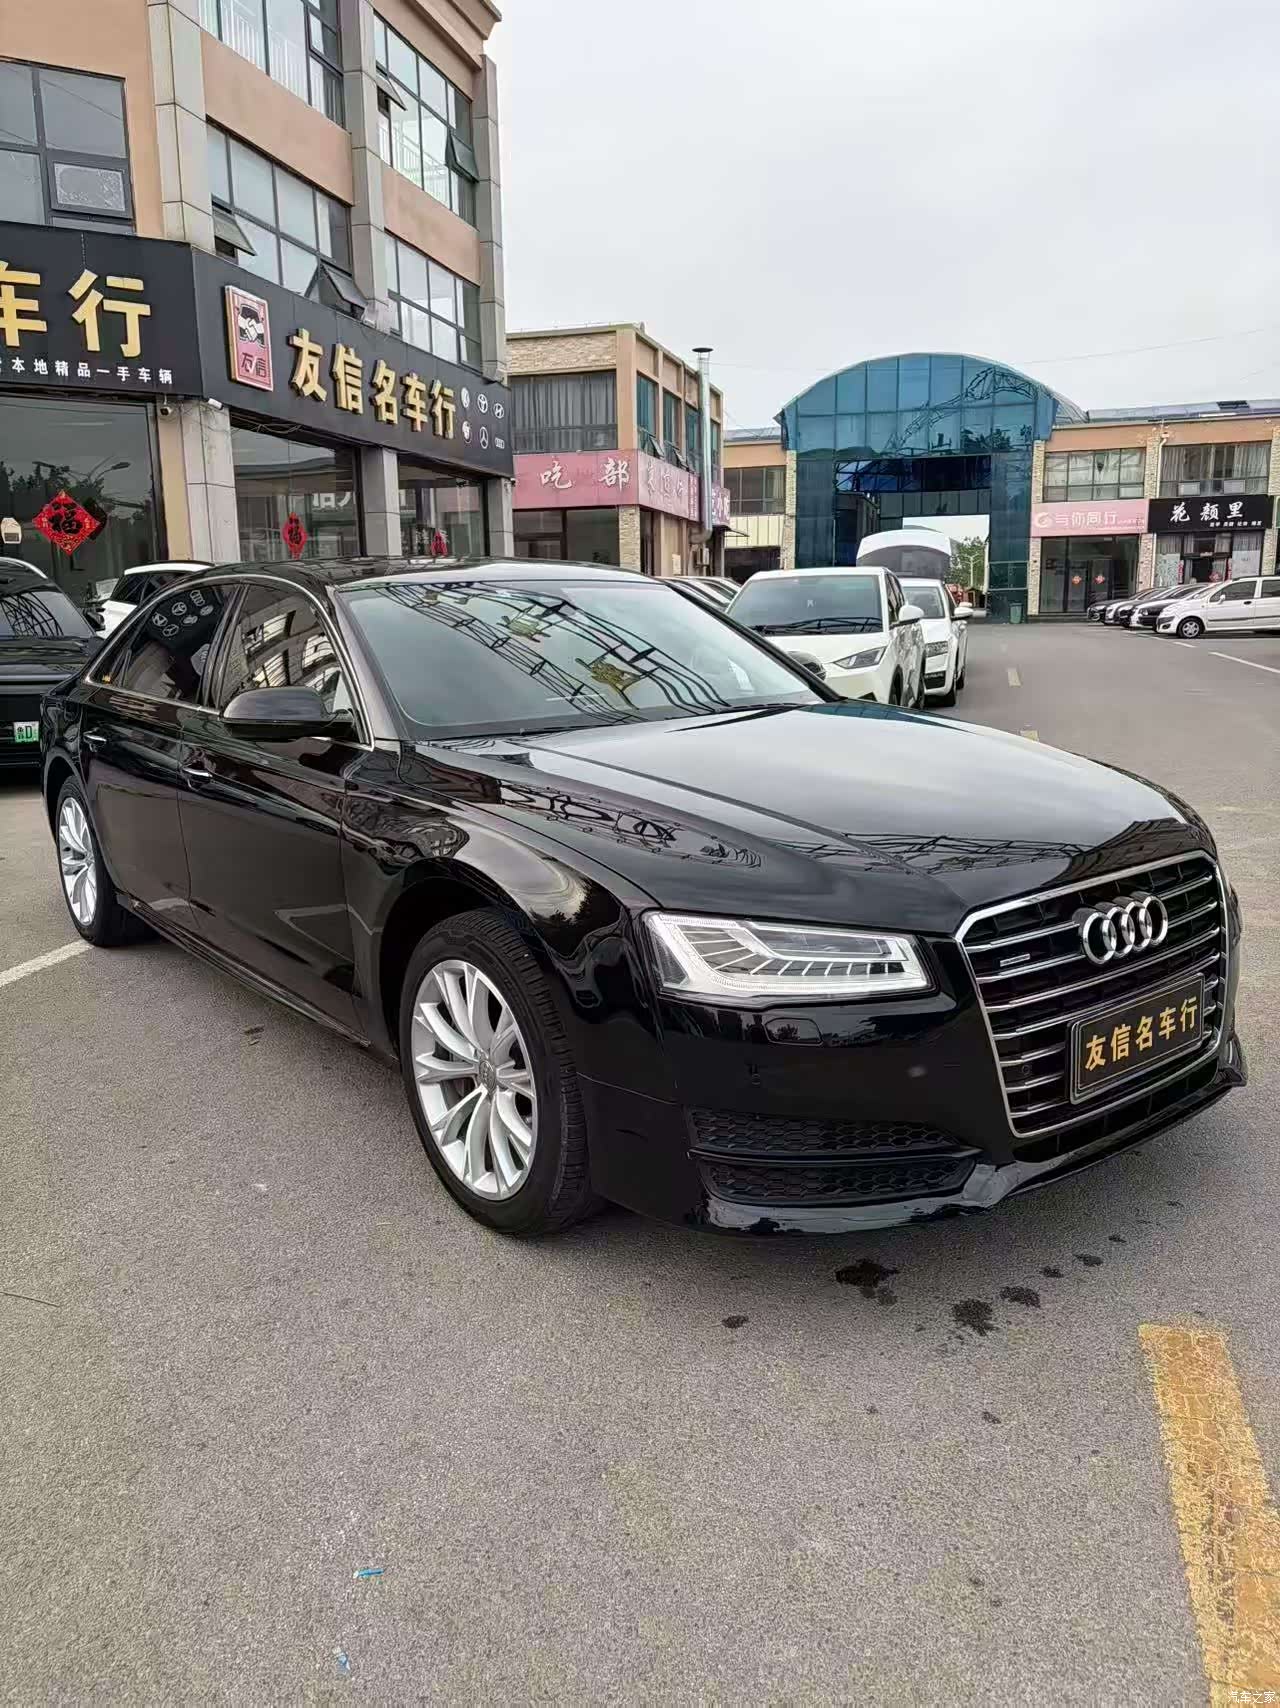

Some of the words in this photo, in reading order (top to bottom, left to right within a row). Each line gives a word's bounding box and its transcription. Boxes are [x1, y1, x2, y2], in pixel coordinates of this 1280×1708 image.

[0, 356, 173, 385] 本地精品一手车辆
[289, 327, 456, 439] 友信名车行
[1056, 511, 1119, 528] 与你同行
[1170, 501, 1244, 522] 花颜里
[1085, 996, 1198, 1071] 友信名车行
